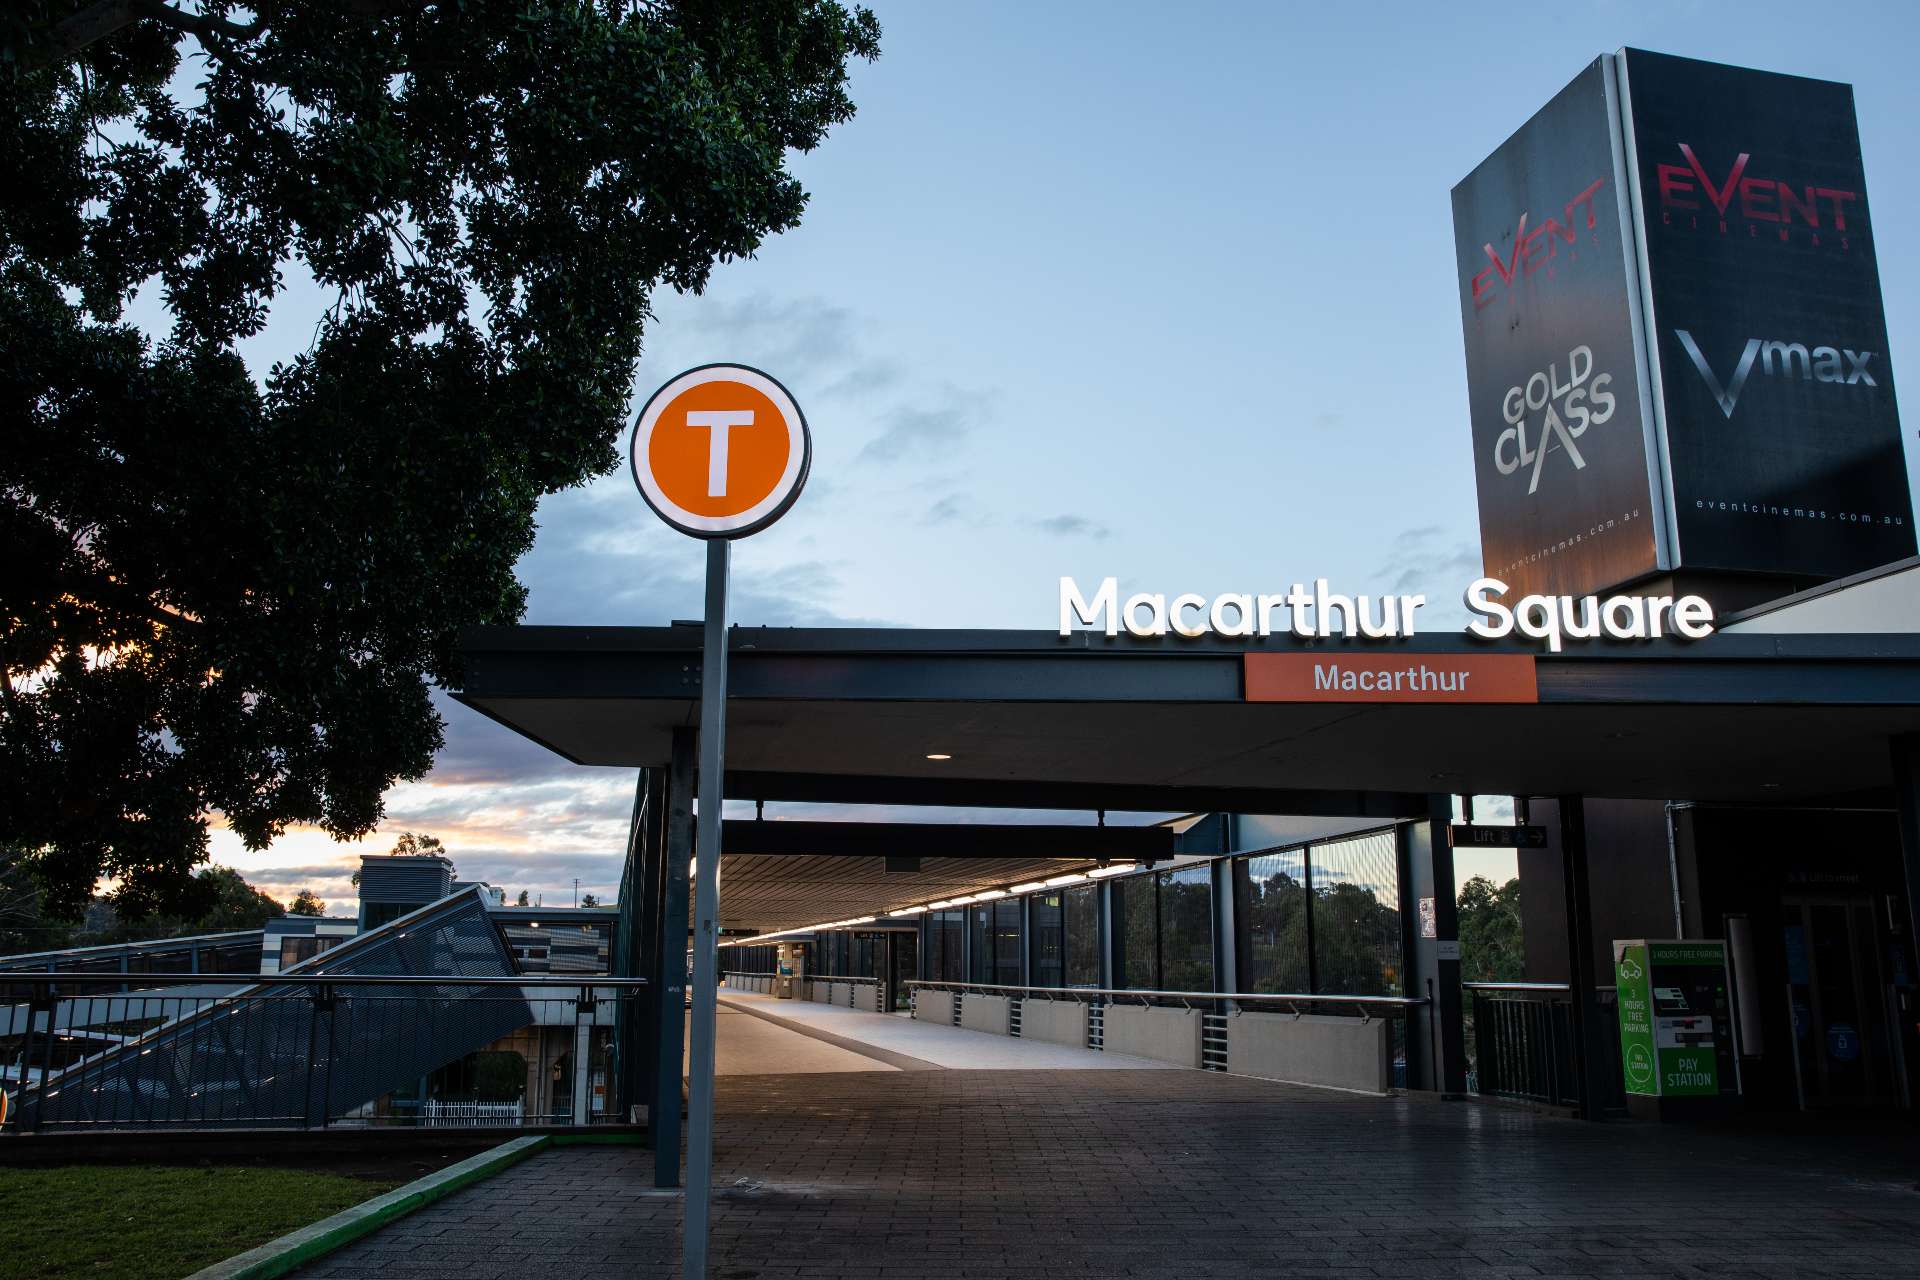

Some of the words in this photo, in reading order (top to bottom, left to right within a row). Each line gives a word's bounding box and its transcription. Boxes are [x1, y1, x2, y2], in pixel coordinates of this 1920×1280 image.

[1657, 143, 1856, 232] EVENT
[1472, 176, 1604, 312] EVENT
[1502, 344, 1593, 425] GOLD
[1674, 329, 1878, 419] Vmax
[1495, 372, 1616, 495] CLASS
[687, 410, 754, 497] T
[1696, 499, 1903, 525] eventcinemas.com.au
[1058, 576, 1426, 639] Macarthur
[1464, 576, 1716, 652] Square
[1314, 664, 1470, 692] Macarthur
[1473, 829, 1496, 843] Lift
[1624, 999, 1645, 1011] HOURS
[1627, 1011, 1643, 1022] FREE
[1624, 1022, 1649, 1033] PARKING
[1678, 1057, 1698, 1072] PAY
[1667, 1072, 1712, 1088] STATION
